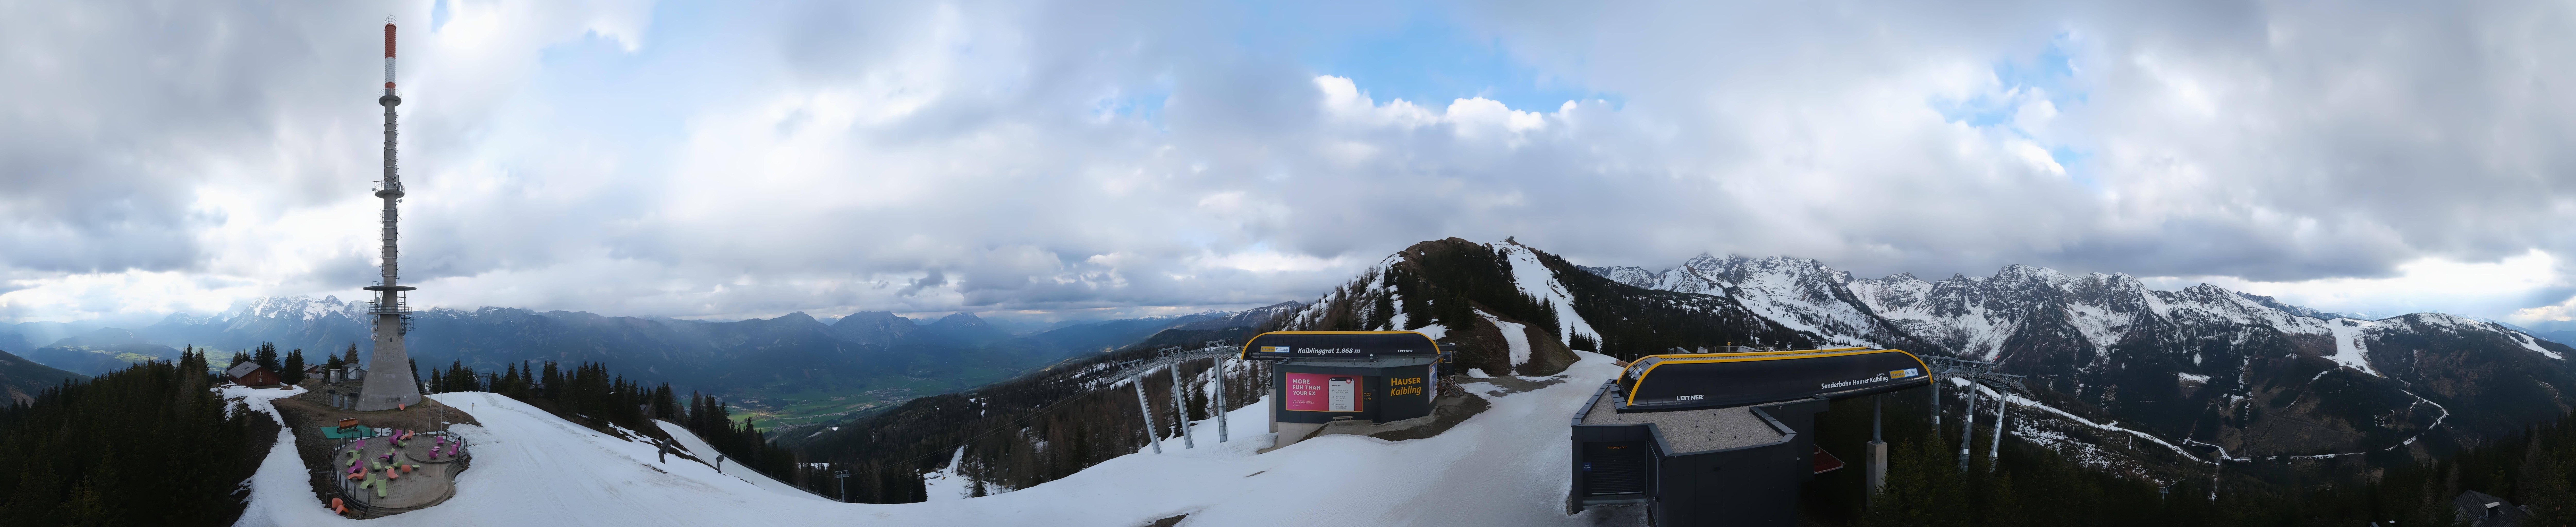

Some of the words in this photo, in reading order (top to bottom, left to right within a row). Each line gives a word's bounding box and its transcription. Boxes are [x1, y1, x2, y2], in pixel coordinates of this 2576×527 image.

[1391, 377, 1421, 386] HAUSER
[1821, 380, 1851, 389] Senderbahn
[1391, 386, 1421, 396] Kaibling
